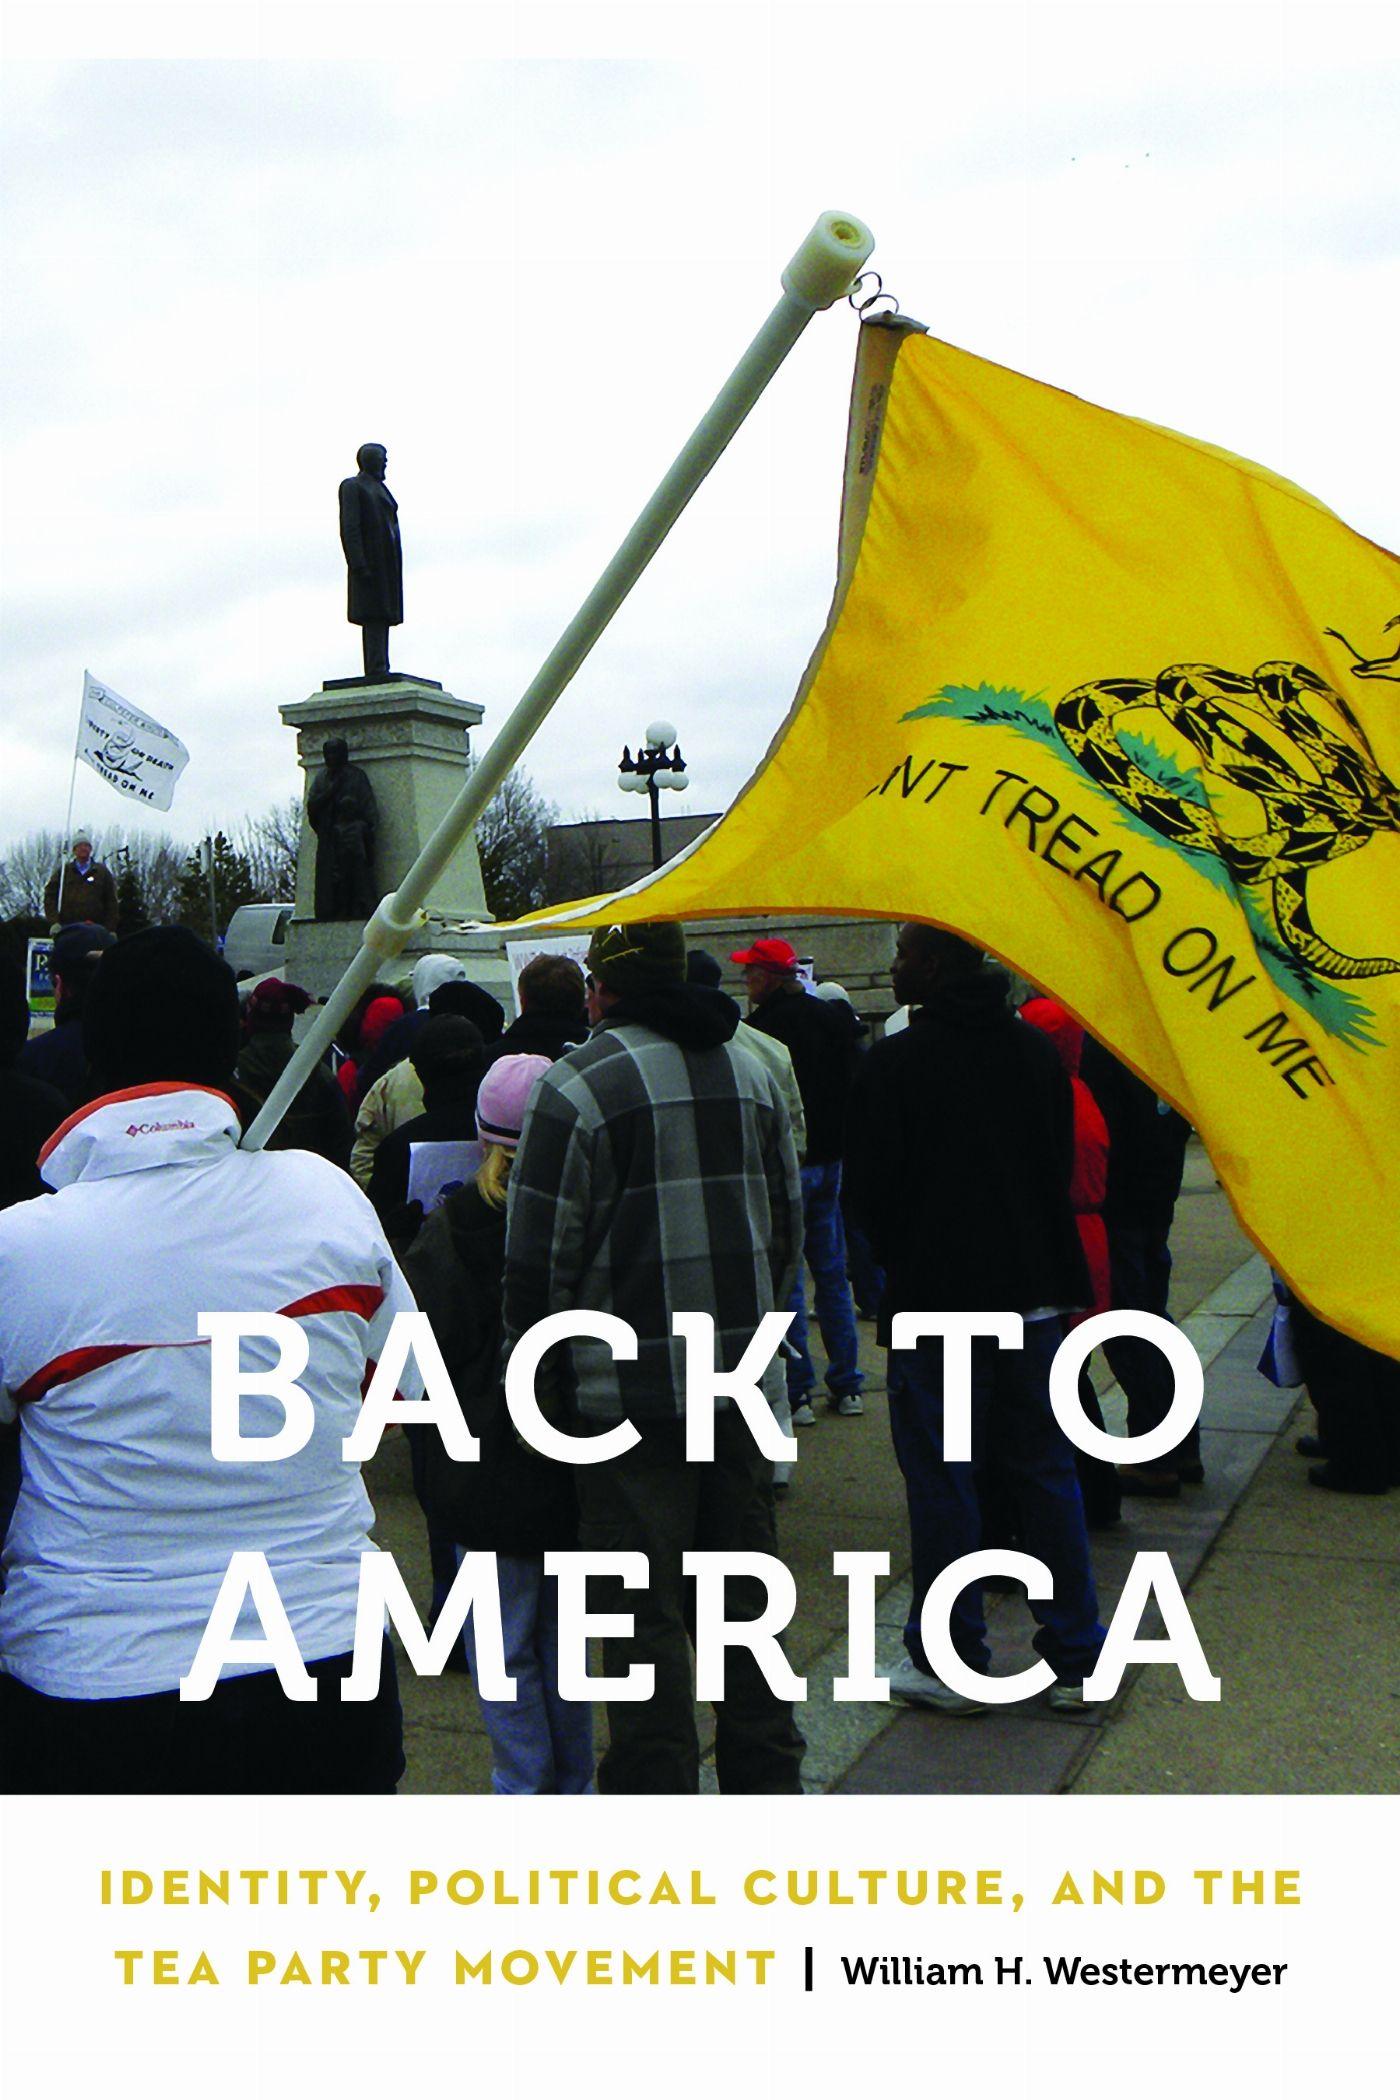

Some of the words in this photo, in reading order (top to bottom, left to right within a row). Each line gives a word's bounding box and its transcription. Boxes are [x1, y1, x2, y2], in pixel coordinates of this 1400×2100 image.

[863, 754, 969, 803] NT
[979, 768, 1163, 925] TREAD
[1161, 926, 1258, 1013] ON
[1243, 1010, 1336, 1100] ME
[139, 1119, 195, 1135] Columbia
